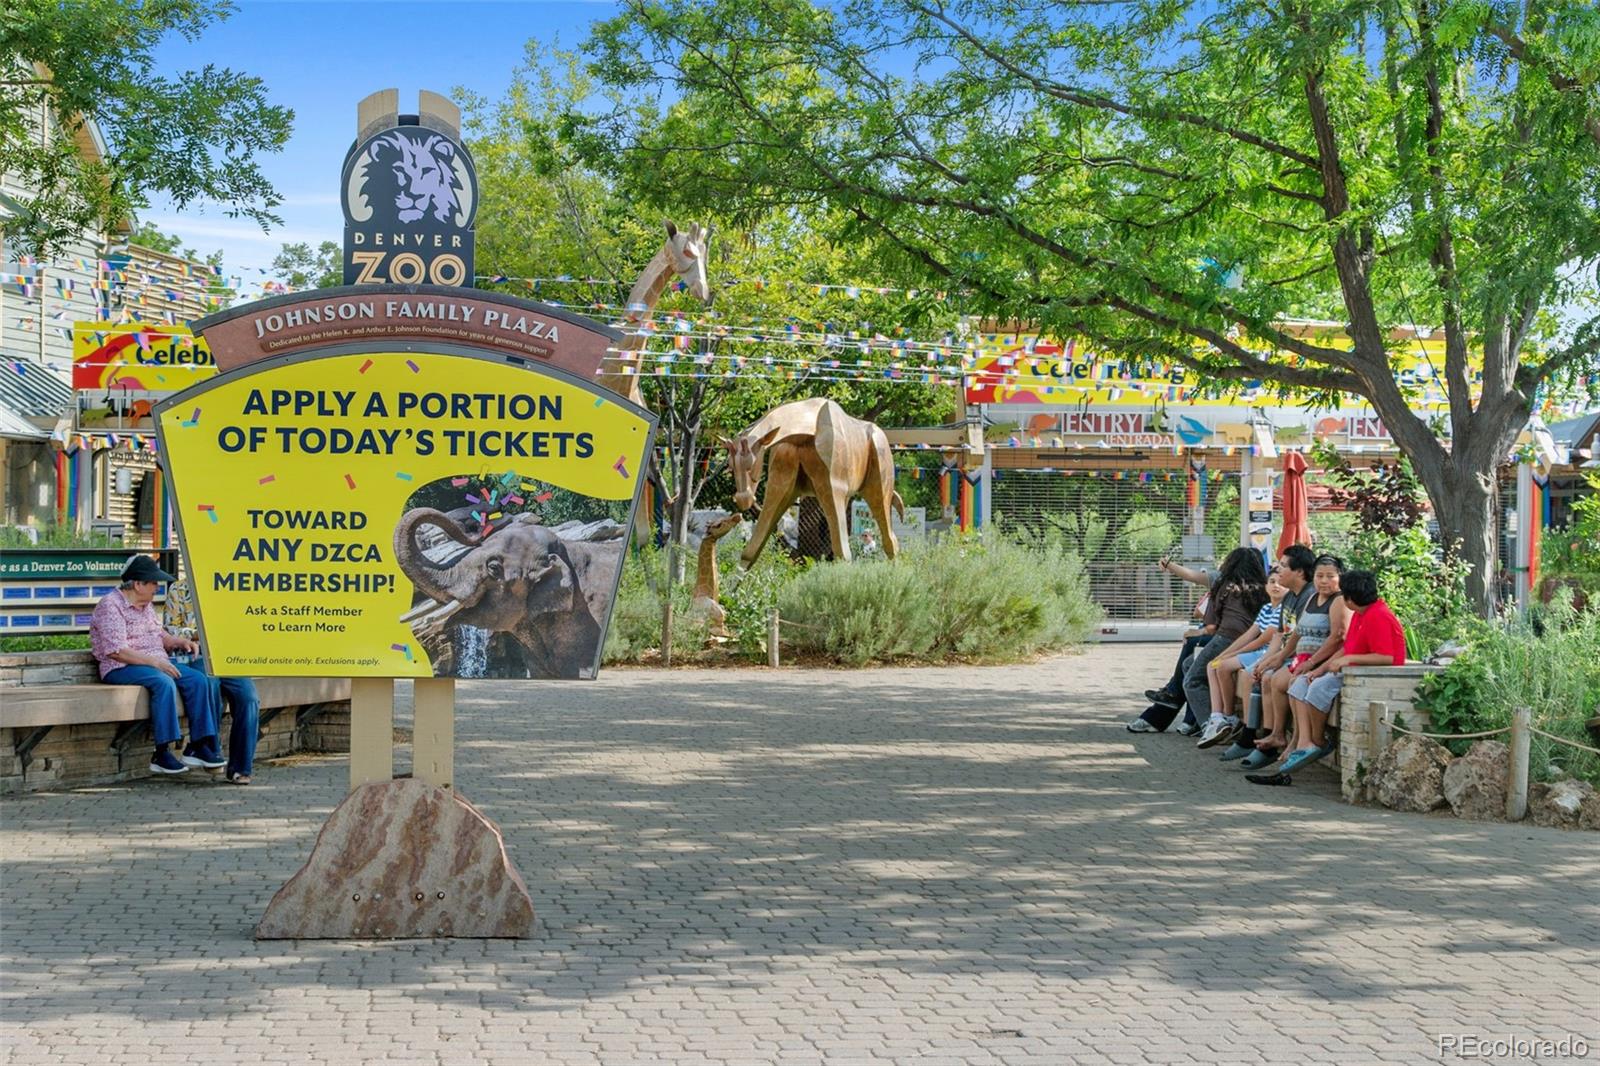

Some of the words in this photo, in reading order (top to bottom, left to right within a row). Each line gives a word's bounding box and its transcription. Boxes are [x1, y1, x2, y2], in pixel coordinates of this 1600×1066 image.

[354, 232, 462, 247] DENVER
[352, 251, 466, 287] ZOO
[255, 302, 374, 338] JOHNSON
[386, 301, 475, 322] FAMILY
[483, 309, 560, 343] PLAZA
[269, 334, 302, 349] Dedicated
[311, 333, 322, 341] the
[323, 328, 343, 338] Helen
[352, 327, 365, 335] and
[366, 324, 387, 334] Arthur
[388, 325, 394, 333] E.
[395, 325, 421, 333] Johnson
[422, 325, 458, 335] Foundation
[459, 329, 469, 337] for
[470, 332, 486, 341] years
[487, 334, 495, 342] of
[495, 336, 523, 349] generous
[524, 344, 548, 355] support
[243, 389, 357, 417] APPLY
[363, 391, 389, 418] A
[398, 392, 563, 421] PORTION
[1065, 413, 1139, 434] ENTRY
[1352, 416, 1390, 438] EN
[218, 426, 267, 453] OF
[275, 427, 435, 456] TODAY’S
[443, 430, 595, 459] TICKETS
[1110, 434, 1171, 446] ENTRADA
[247, 510, 368, 530] TOWARD
[232, 538, 303, 562] ANY
[310, 543, 383, 563] DZCA
[9, 562, 21, 572] as
[22, 562, 29, 572] a
[31, 561, 65, 572] Denver
[66, 561, 83, 571] Zoo
[213, 572, 395, 594] MEMBERSHIP!
[245, 605, 267, 616] Ask
[271, 608, 278, 616] a
[281, 605, 310, 616] Staff
[313, 606, 363, 617] Member
[262, 623, 275, 632] to
[279, 622, 312, 632] Learn
[315, 622, 346, 633] More
[226, 656, 247, 664] Offer
[248, 656, 268, 665] valid
[269, 656, 293, 665] onsite
[295, 656, 314, 667] only.
[315, 657, 355, 666] Exclusions
[356, 658, 380, 668] apply.
